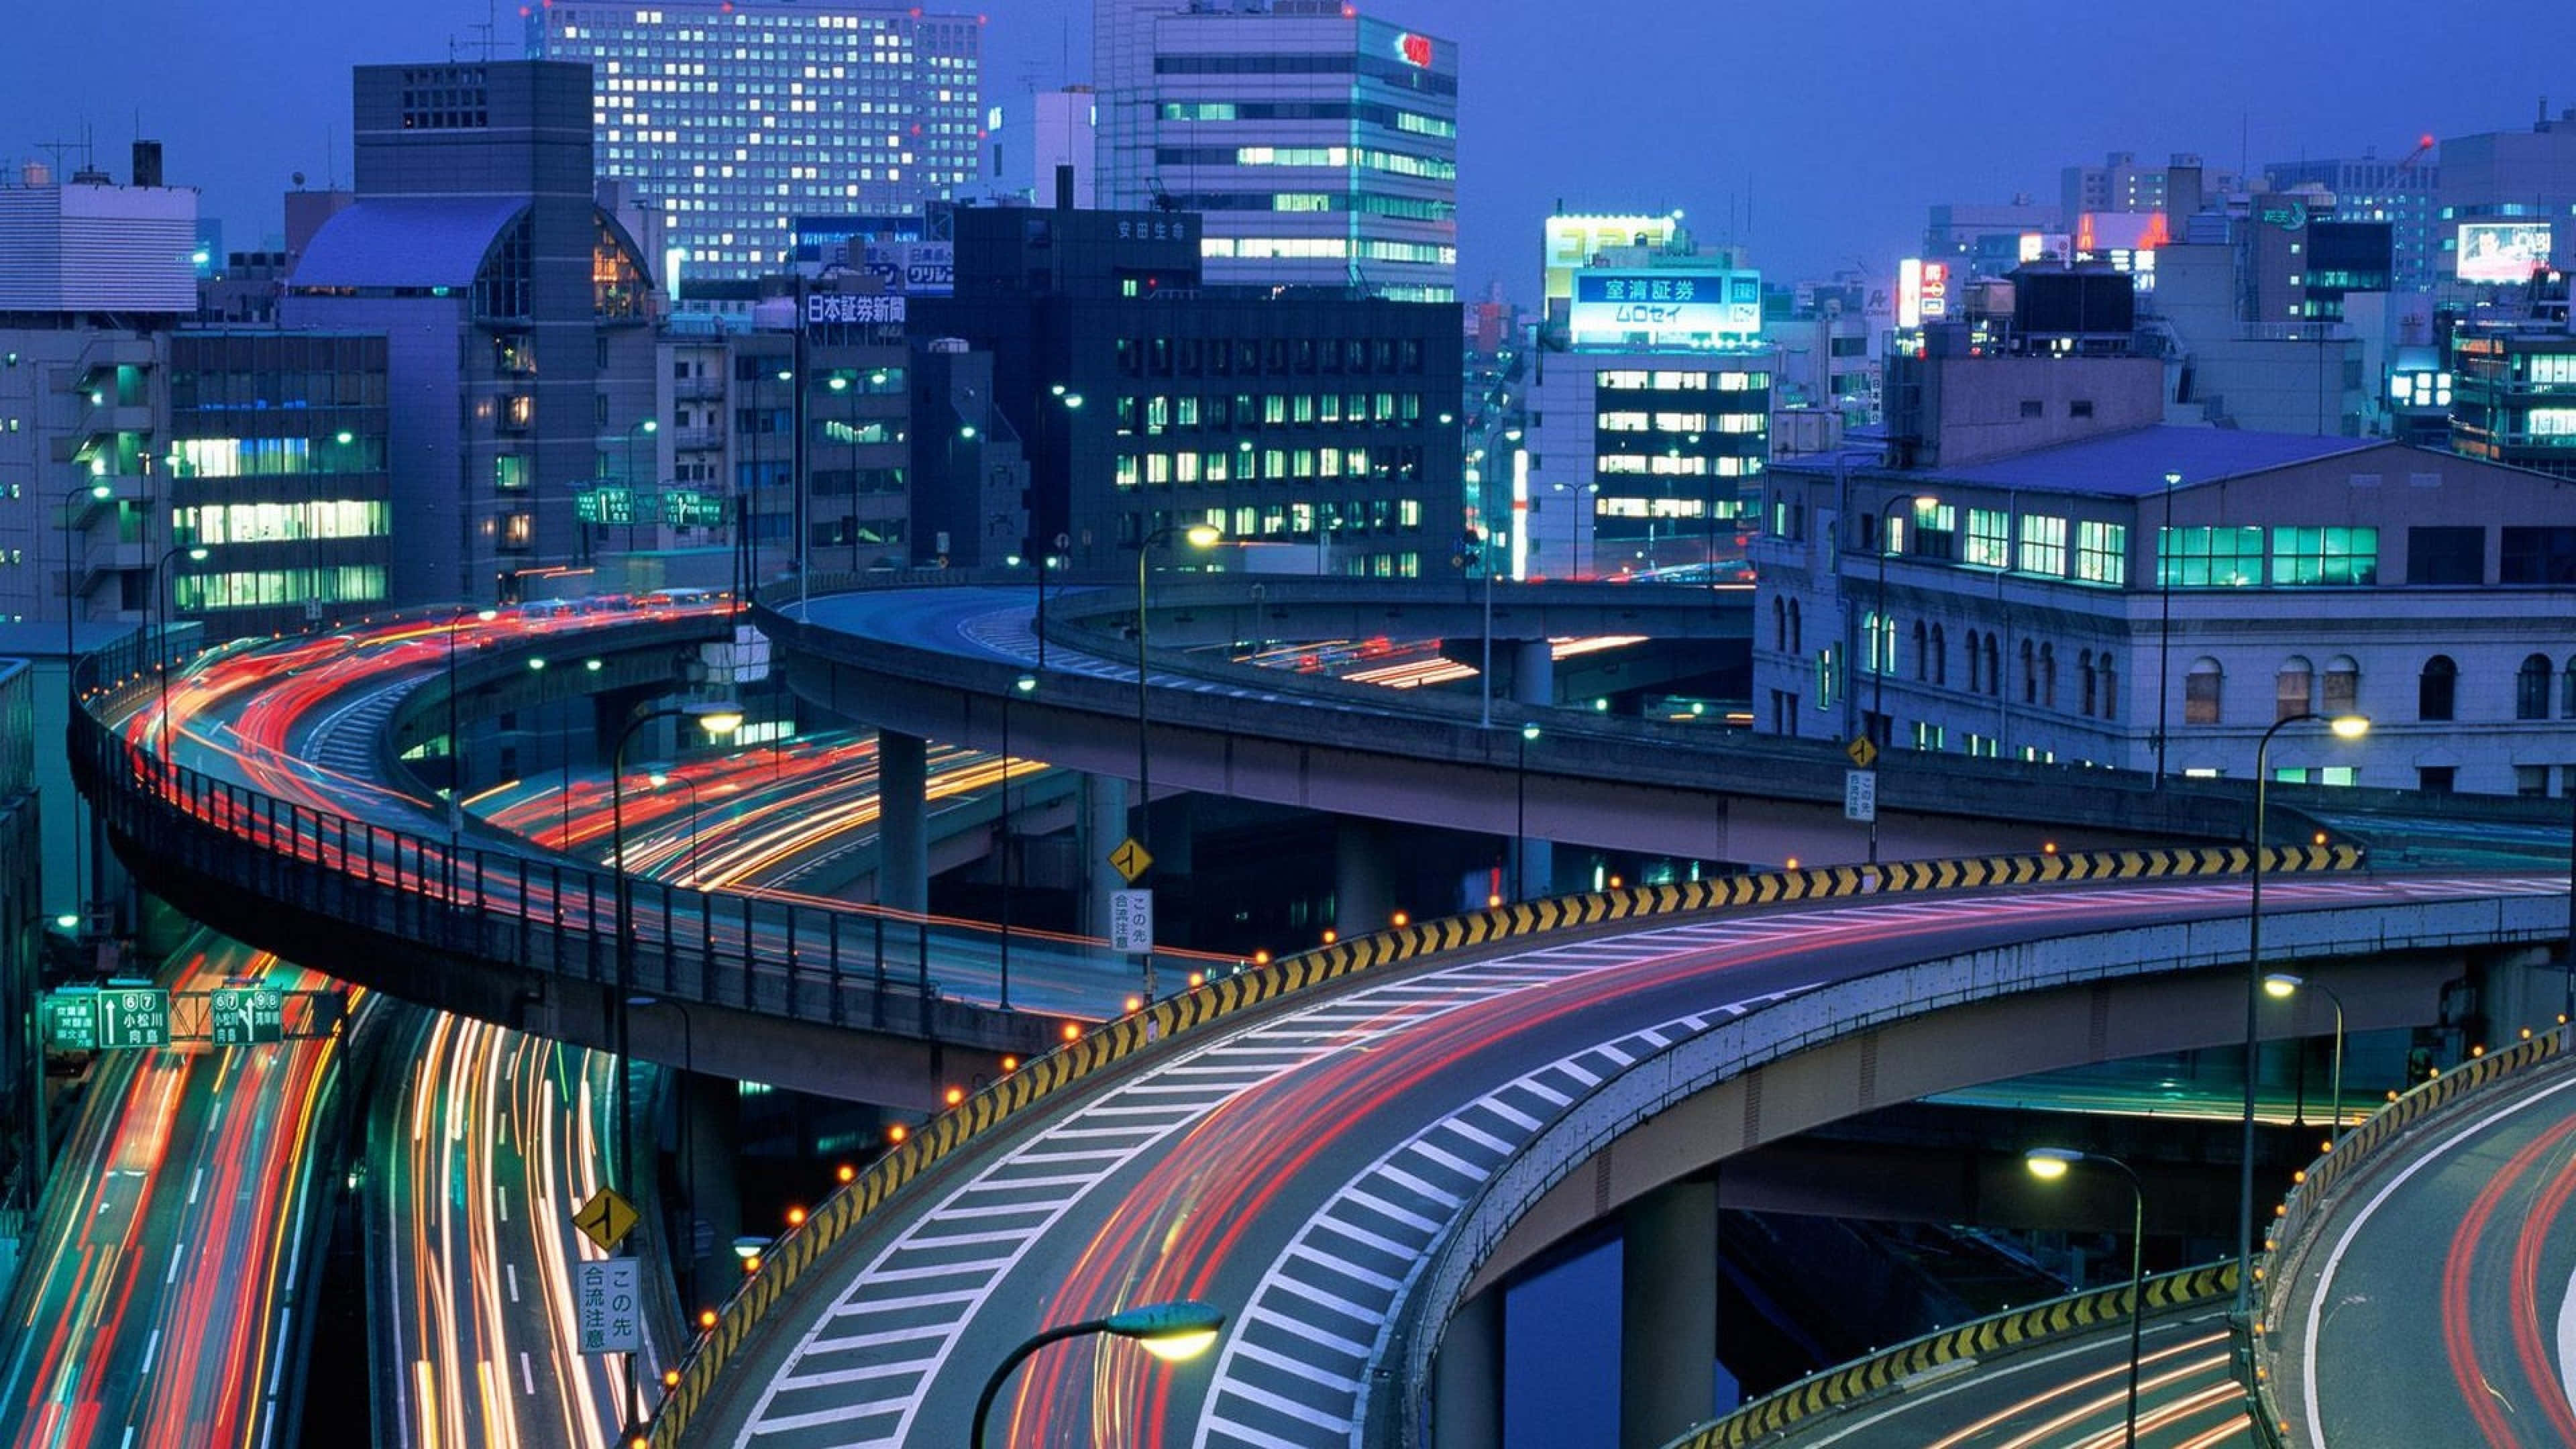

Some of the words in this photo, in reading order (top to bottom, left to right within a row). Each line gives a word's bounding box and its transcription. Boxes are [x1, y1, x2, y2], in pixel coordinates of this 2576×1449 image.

[808, 295, 905, 322] 日本証券新聞
[1616, 306, 1682, 323] ムロセイ
[1132, 895, 1147, 944] この先
[123, 1013, 163, 1028] 小松川
[584, 1266, 604, 1348] 合流注意
[612, 1271, 632, 1338] この先
